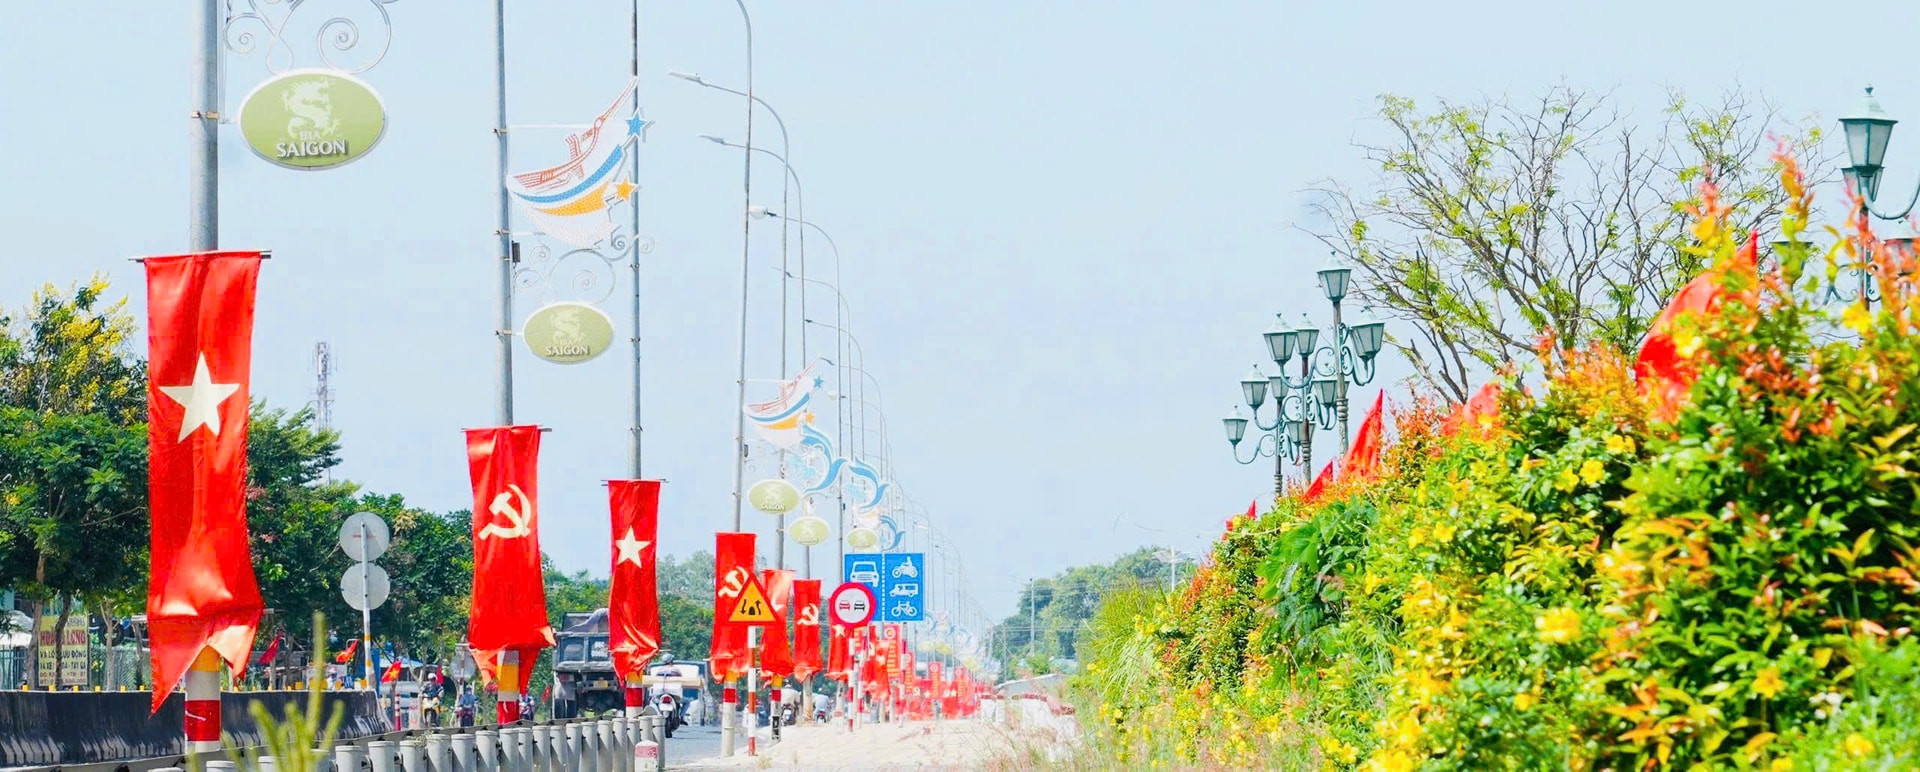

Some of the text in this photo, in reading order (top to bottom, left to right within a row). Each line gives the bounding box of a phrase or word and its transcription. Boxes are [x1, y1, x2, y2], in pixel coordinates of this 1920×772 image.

[299, 131, 321, 140] BIA
[276, 140, 348, 158] SAIGON
[545, 345, 590, 357] SAIGON
